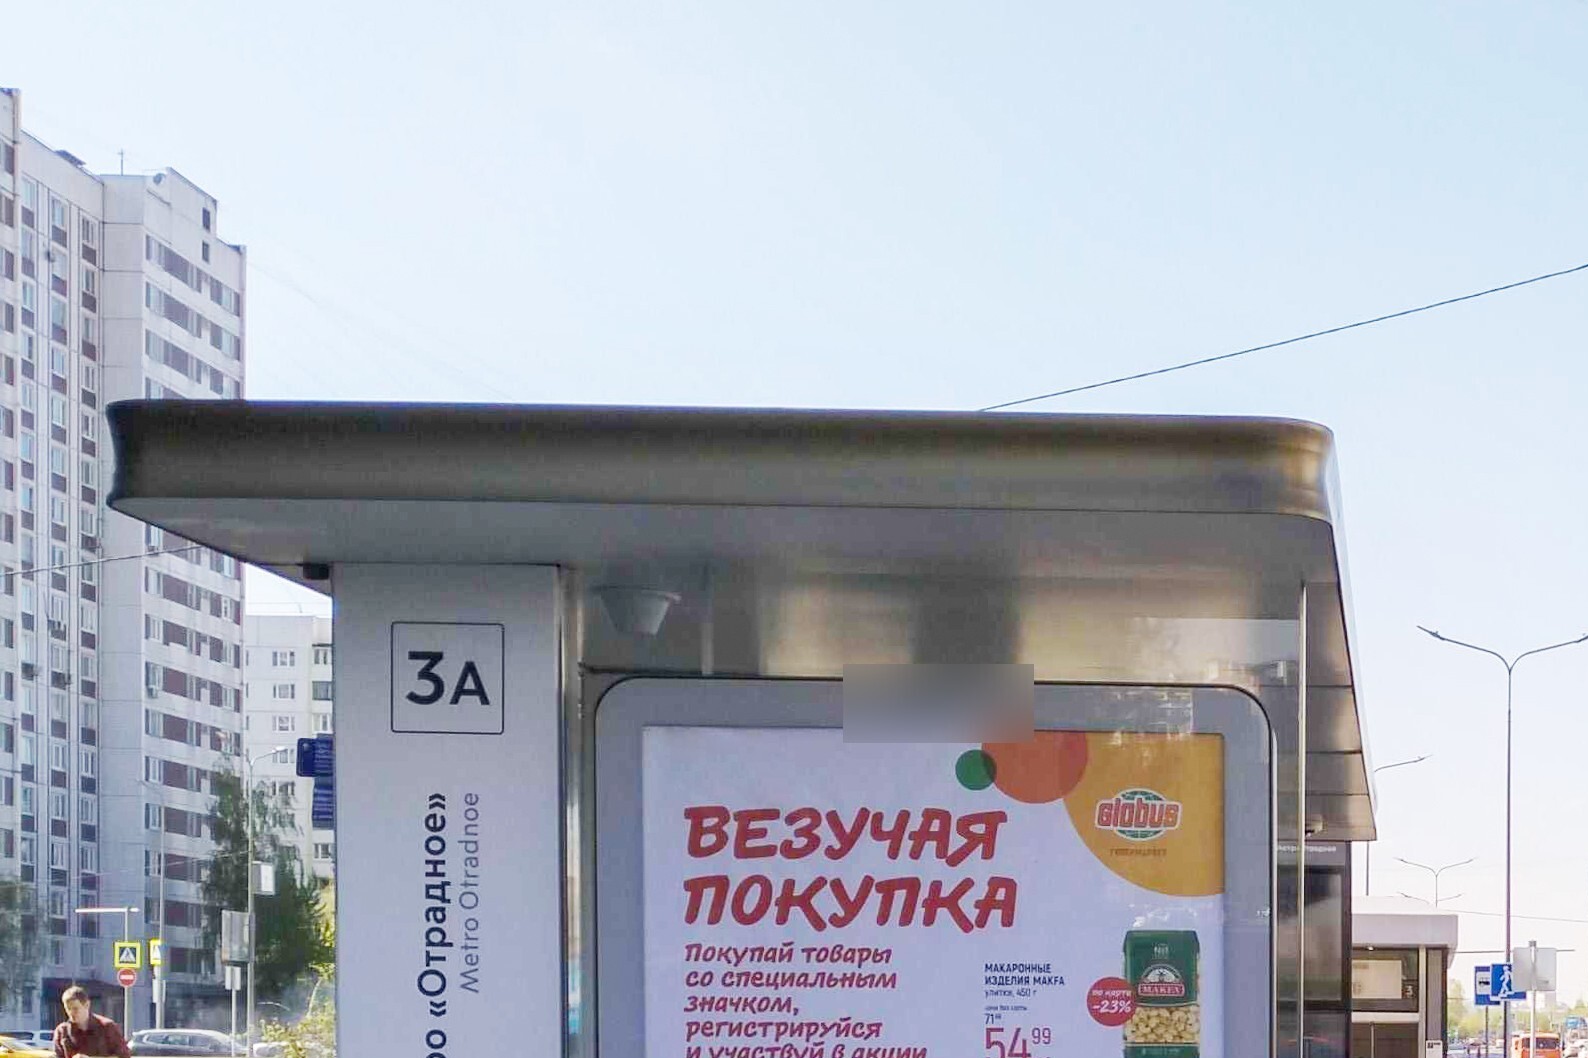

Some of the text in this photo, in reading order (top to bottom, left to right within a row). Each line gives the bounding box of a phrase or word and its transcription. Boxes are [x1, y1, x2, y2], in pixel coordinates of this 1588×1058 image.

[684, 805, 1007, 867] ВЕЗУЧАЯ
[417, 792, 453, 1016] «Отрадное»
[459, 792, 479, 993] Metro Otradnoe
[683, 874, 1018, 934] ПОКУПКА
[684, 942, 891, 967] Покупай товары
[685, 969, 896, 991] со специальным
[985, 963, 1051, 974] МАКАРОННЫЕ
[985, 975, 1030, 986] ИЗДЕЛИЯ
[684, 997, 800, 1017] значком,
[685, 1018, 882, 1043] регистрируйся
